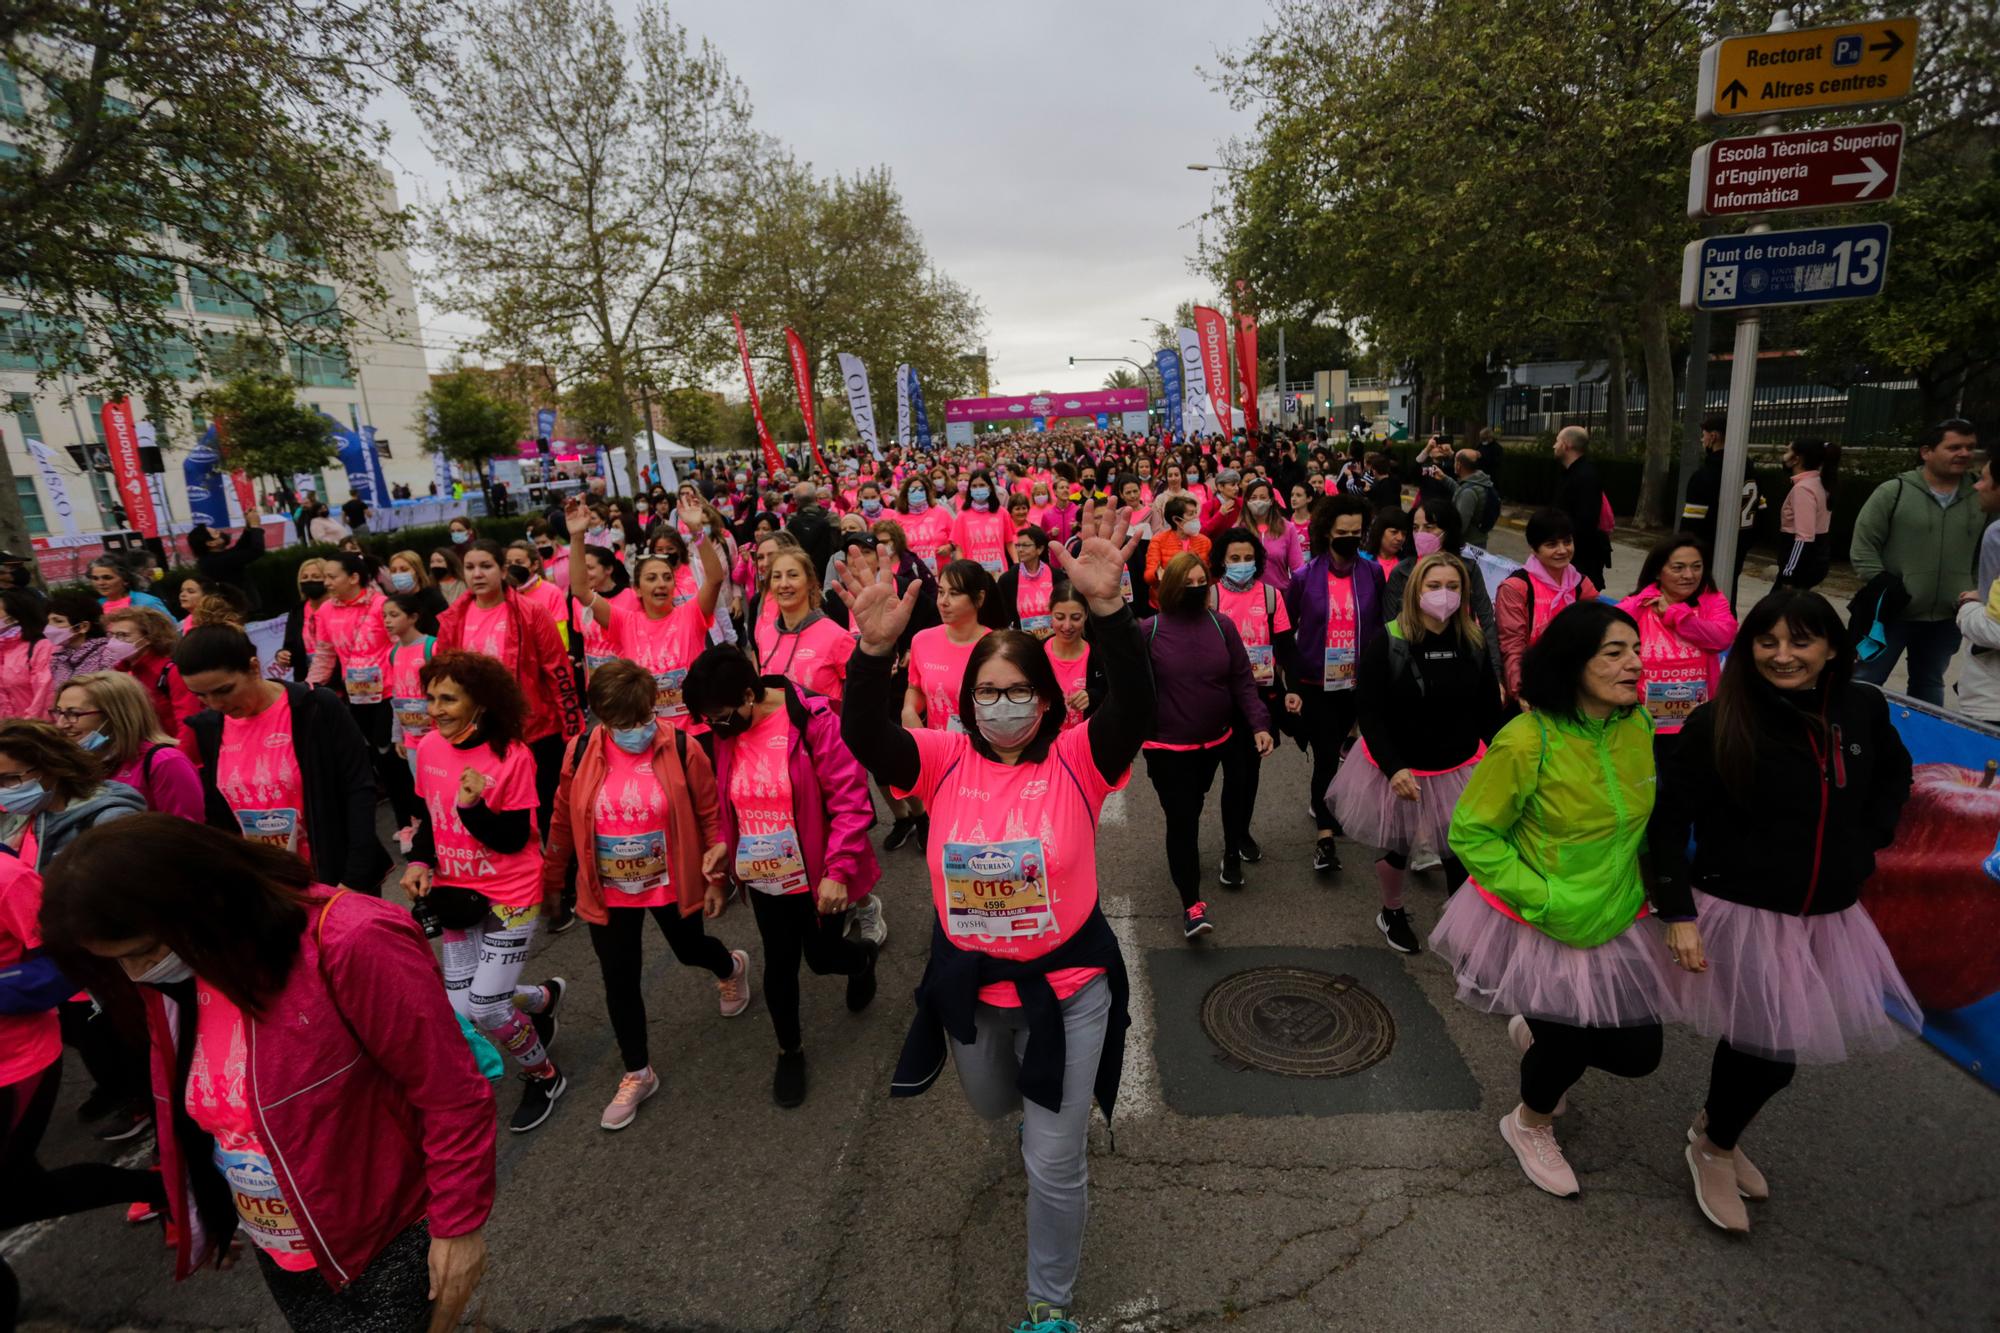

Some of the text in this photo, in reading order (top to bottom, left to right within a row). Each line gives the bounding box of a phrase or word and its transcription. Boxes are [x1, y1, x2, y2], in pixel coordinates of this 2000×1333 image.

[1747, 44, 1822, 67] Rectorat
[1836, 41, 1850, 62] P
[1761, 72, 1887, 100] Altres centres
[1717, 132, 1899, 163] Escola Tècnica Superior
[1715, 163, 1808, 186] d'Enginyeria
[1714, 188, 1799, 208] Informàtica
[1706, 238, 1881, 287] Punt de trobada 13
[112, 409, 138, 478] Santander
[1643, 668, 1708, 678] TU DORSAL
[554, 666, 580, 736] adidas
[1665, 700, 1689, 709] 016
[745, 810, 795, 821] DORSAL
[438, 844, 492, 860] DORSAL
[616, 858, 645, 870] 016
[752, 859, 779, 871] 016
[971, 859, 1011, 871] ASTURIANA
[973, 880, 1013, 896] 016
[983, 901, 1006, 909] 4596
[480, 950, 529, 965] OF THE
[237, 1192, 286, 1215] 016
